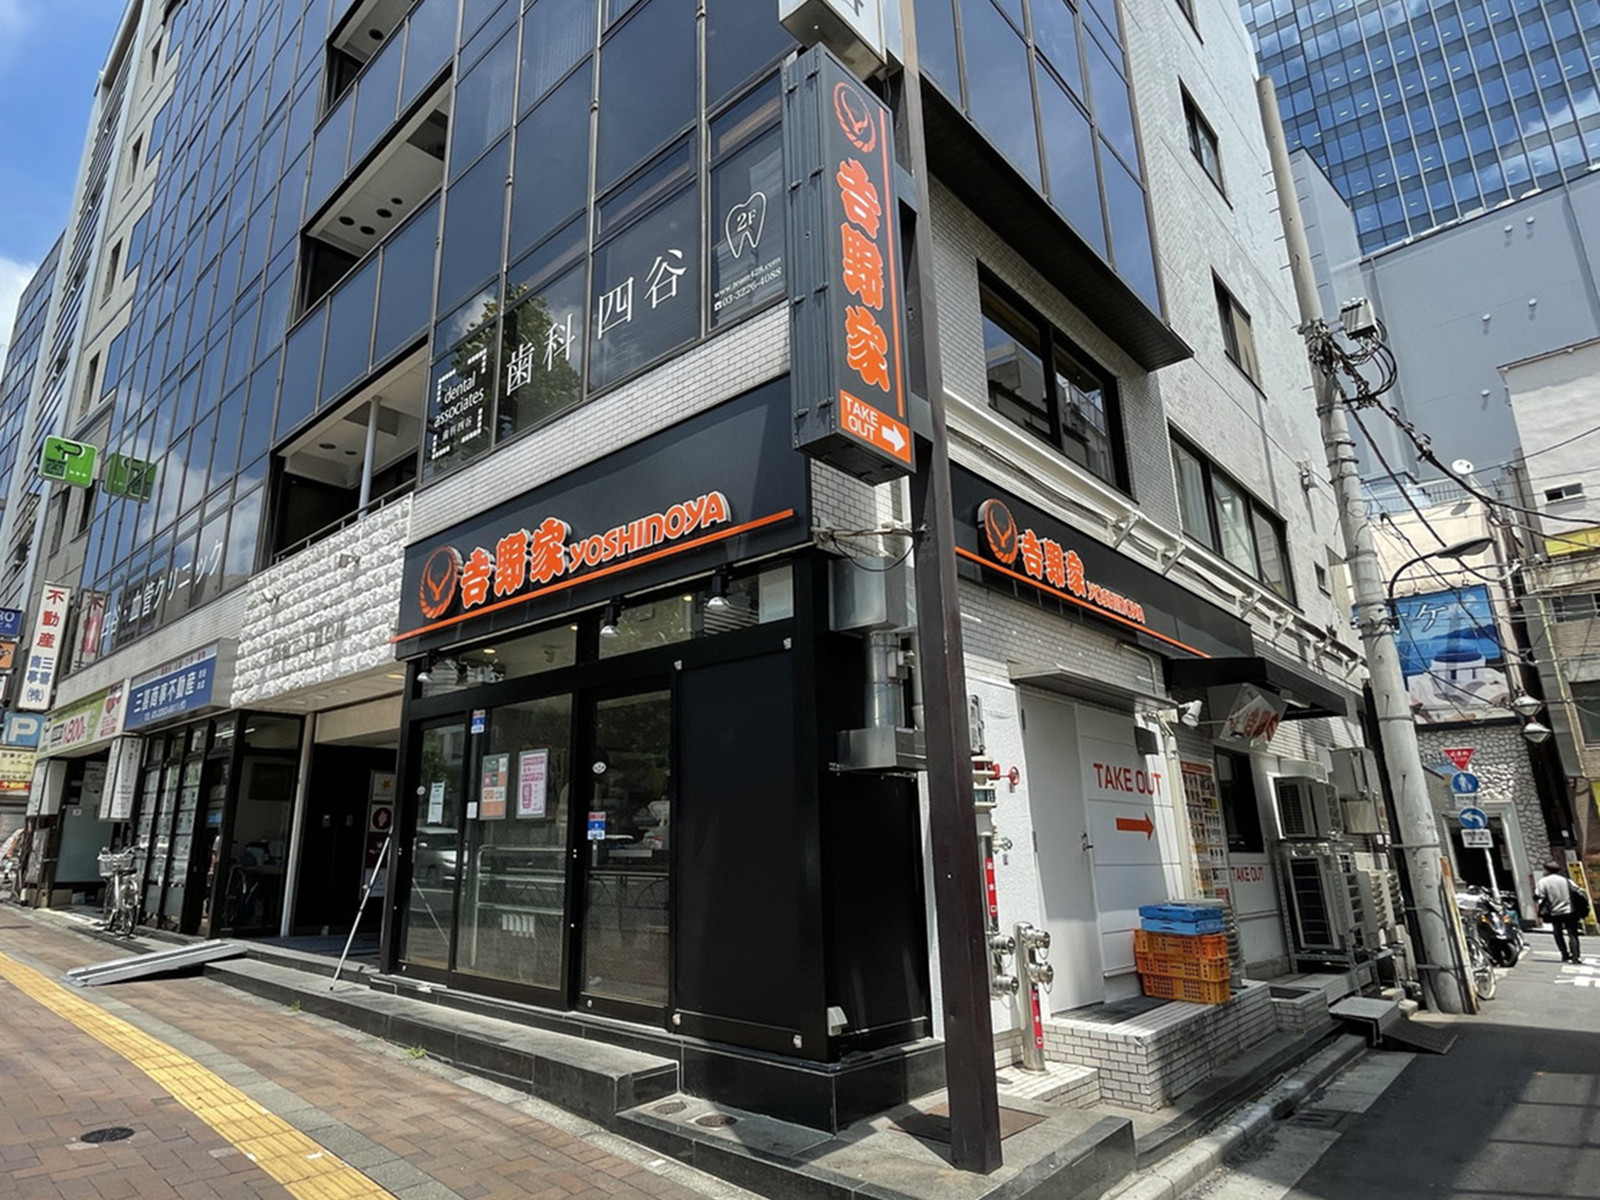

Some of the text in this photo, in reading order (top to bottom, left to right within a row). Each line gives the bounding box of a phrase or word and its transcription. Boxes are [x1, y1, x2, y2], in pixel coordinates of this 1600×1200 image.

[736, 209, 757, 232] 2F
[837, 157, 888, 392] 吉野家
[506, 249, 687, 396] 歯科四谷
[443, 370, 477, 404] dental
[433, 387, 485, 428] associates
[844, 395, 878, 428] TAKE
[848, 415, 876, 440] OUT
[460, 491, 731, 609] 吉野家 YOSHINOYA
[1020, 528, 1086, 598] 吉野家
[37, 588, 66, 649] 不動産
[8, 717, 38, 742] P
[1093, 763, 1162, 796] TAKE OUT
[1231, 866, 1264, 882] TAKE OUT
